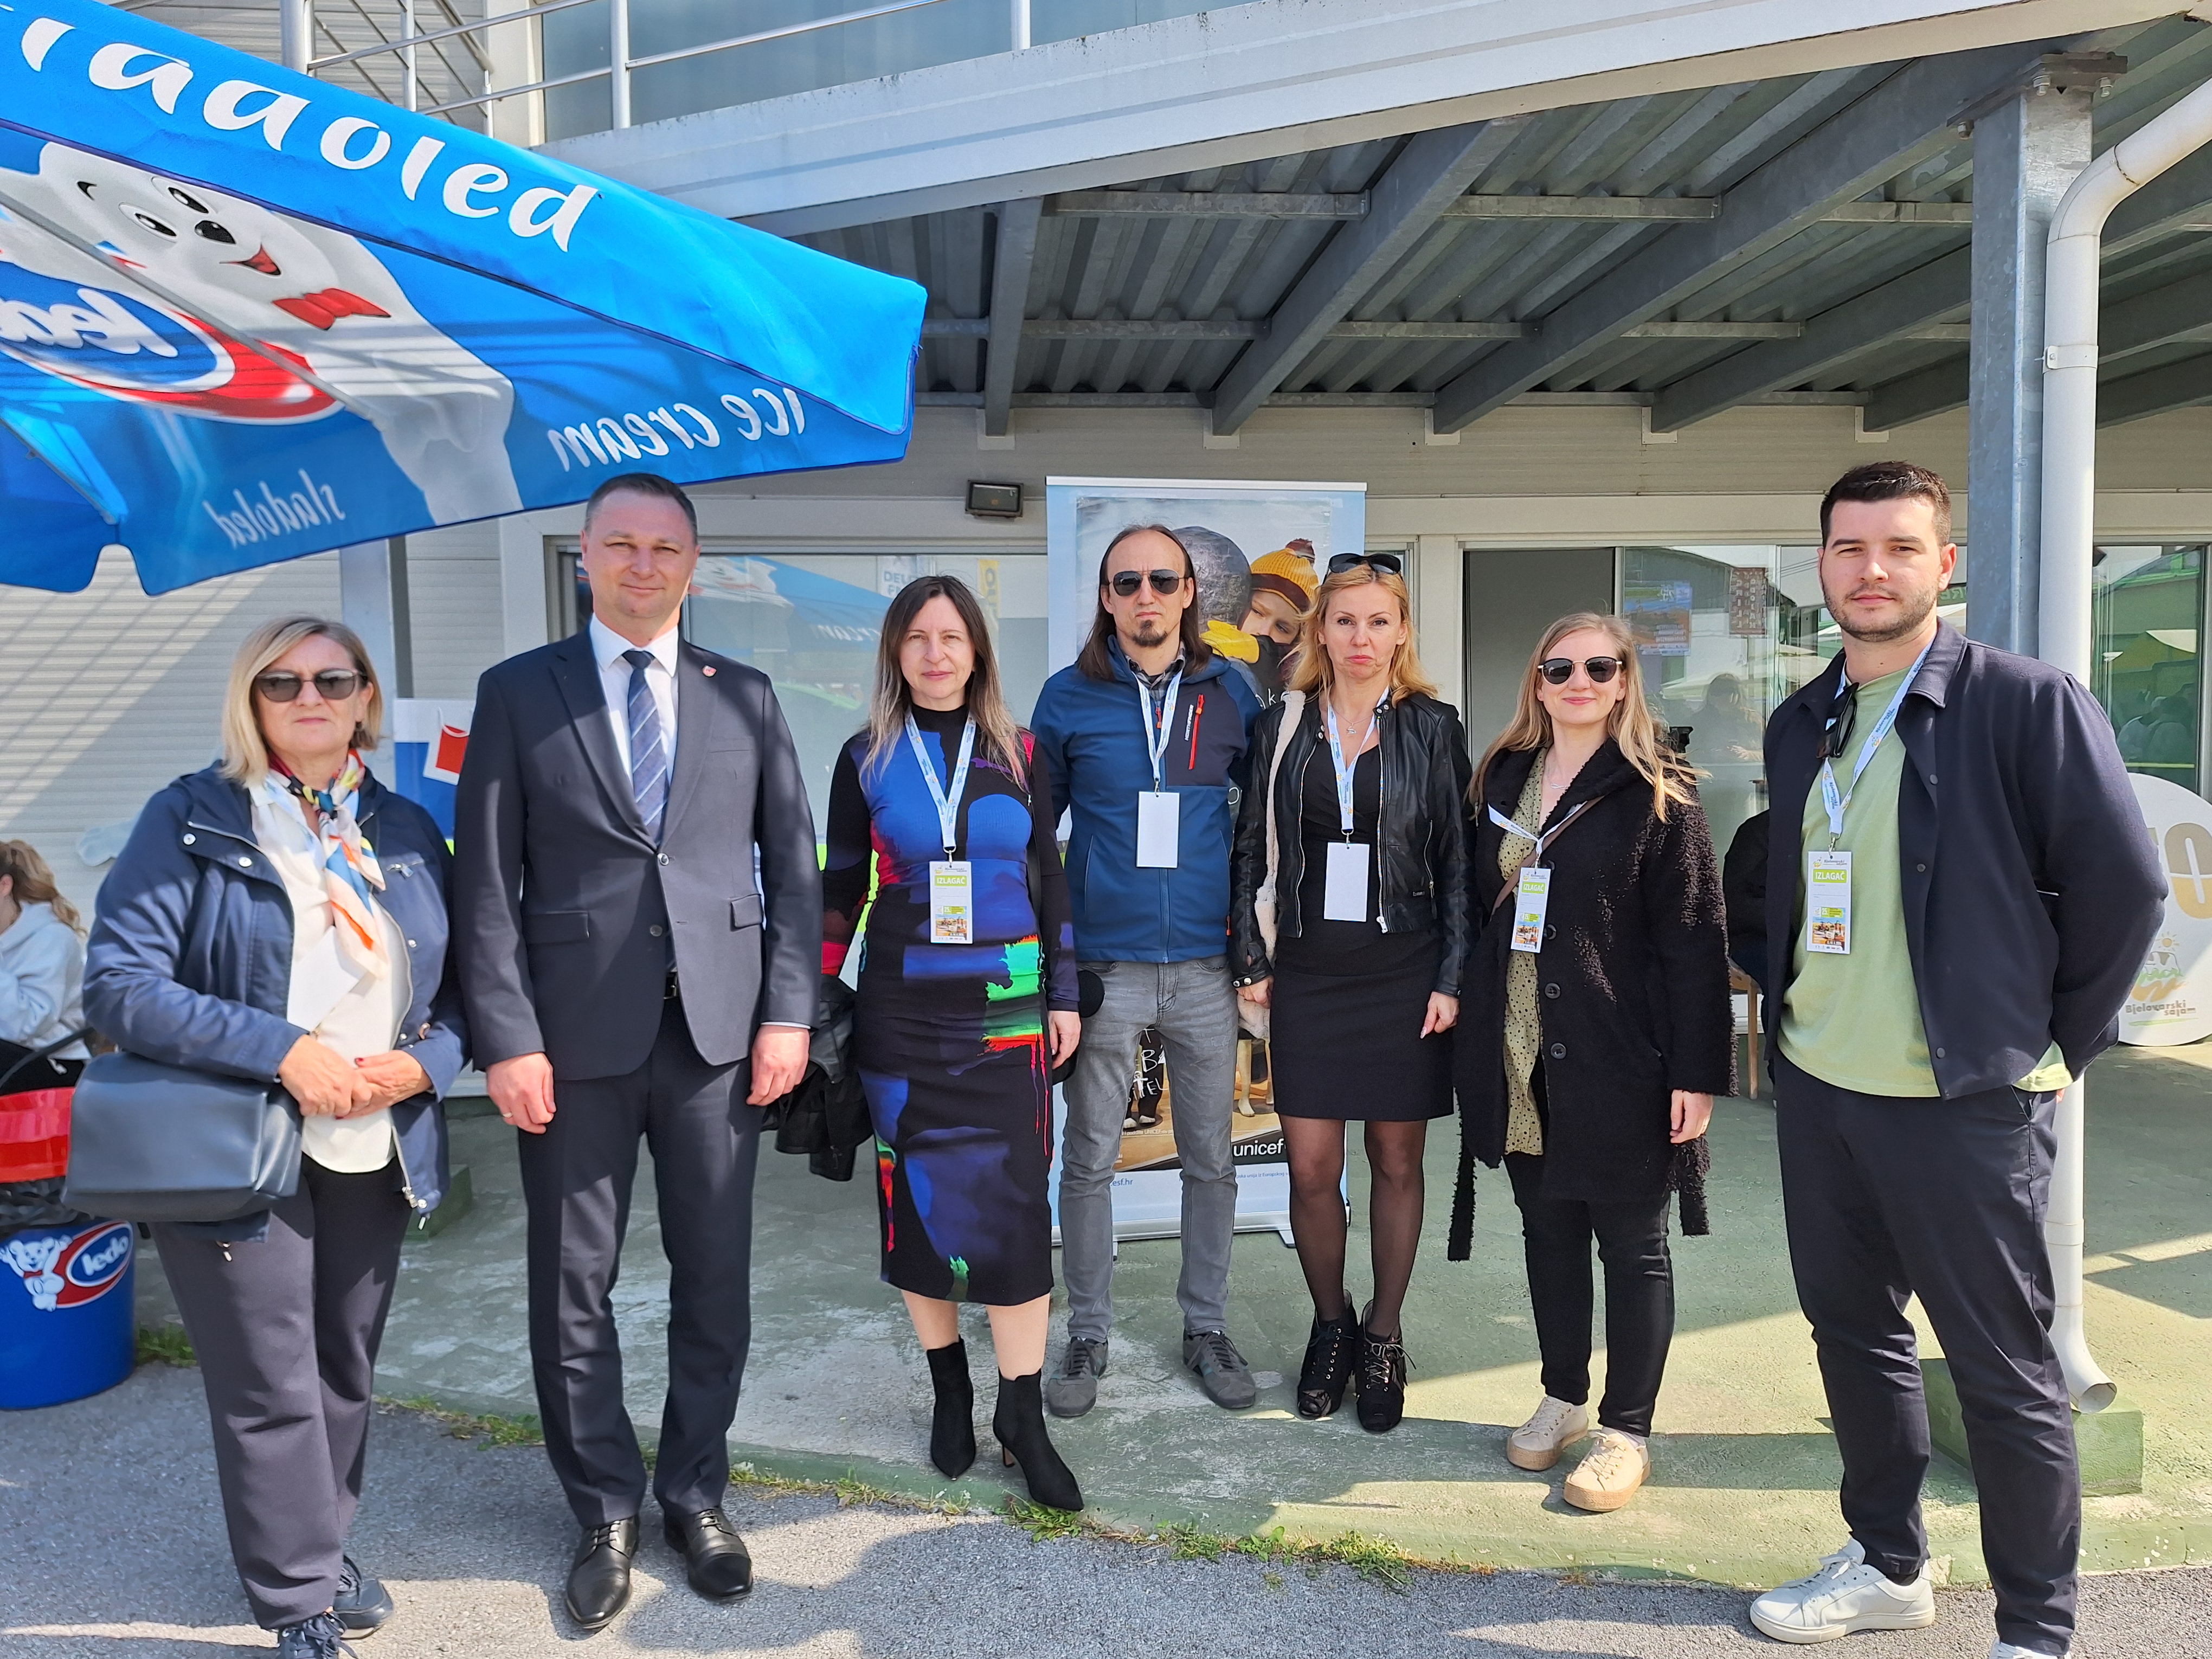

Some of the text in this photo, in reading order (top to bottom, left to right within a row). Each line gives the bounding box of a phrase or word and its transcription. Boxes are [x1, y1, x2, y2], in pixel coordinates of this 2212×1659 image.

[937, 876, 966, 885] IZLAGAČ
[1815, 871, 1845, 880] IZLAGAČ
[1523, 883, 1544, 892] IZLAGAČ
[2125, 1000, 2187, 1015] Bjelovarski
[1233, 1138, 1284, 1156] unicef
[80, 1236, 129, 1277] ledo
